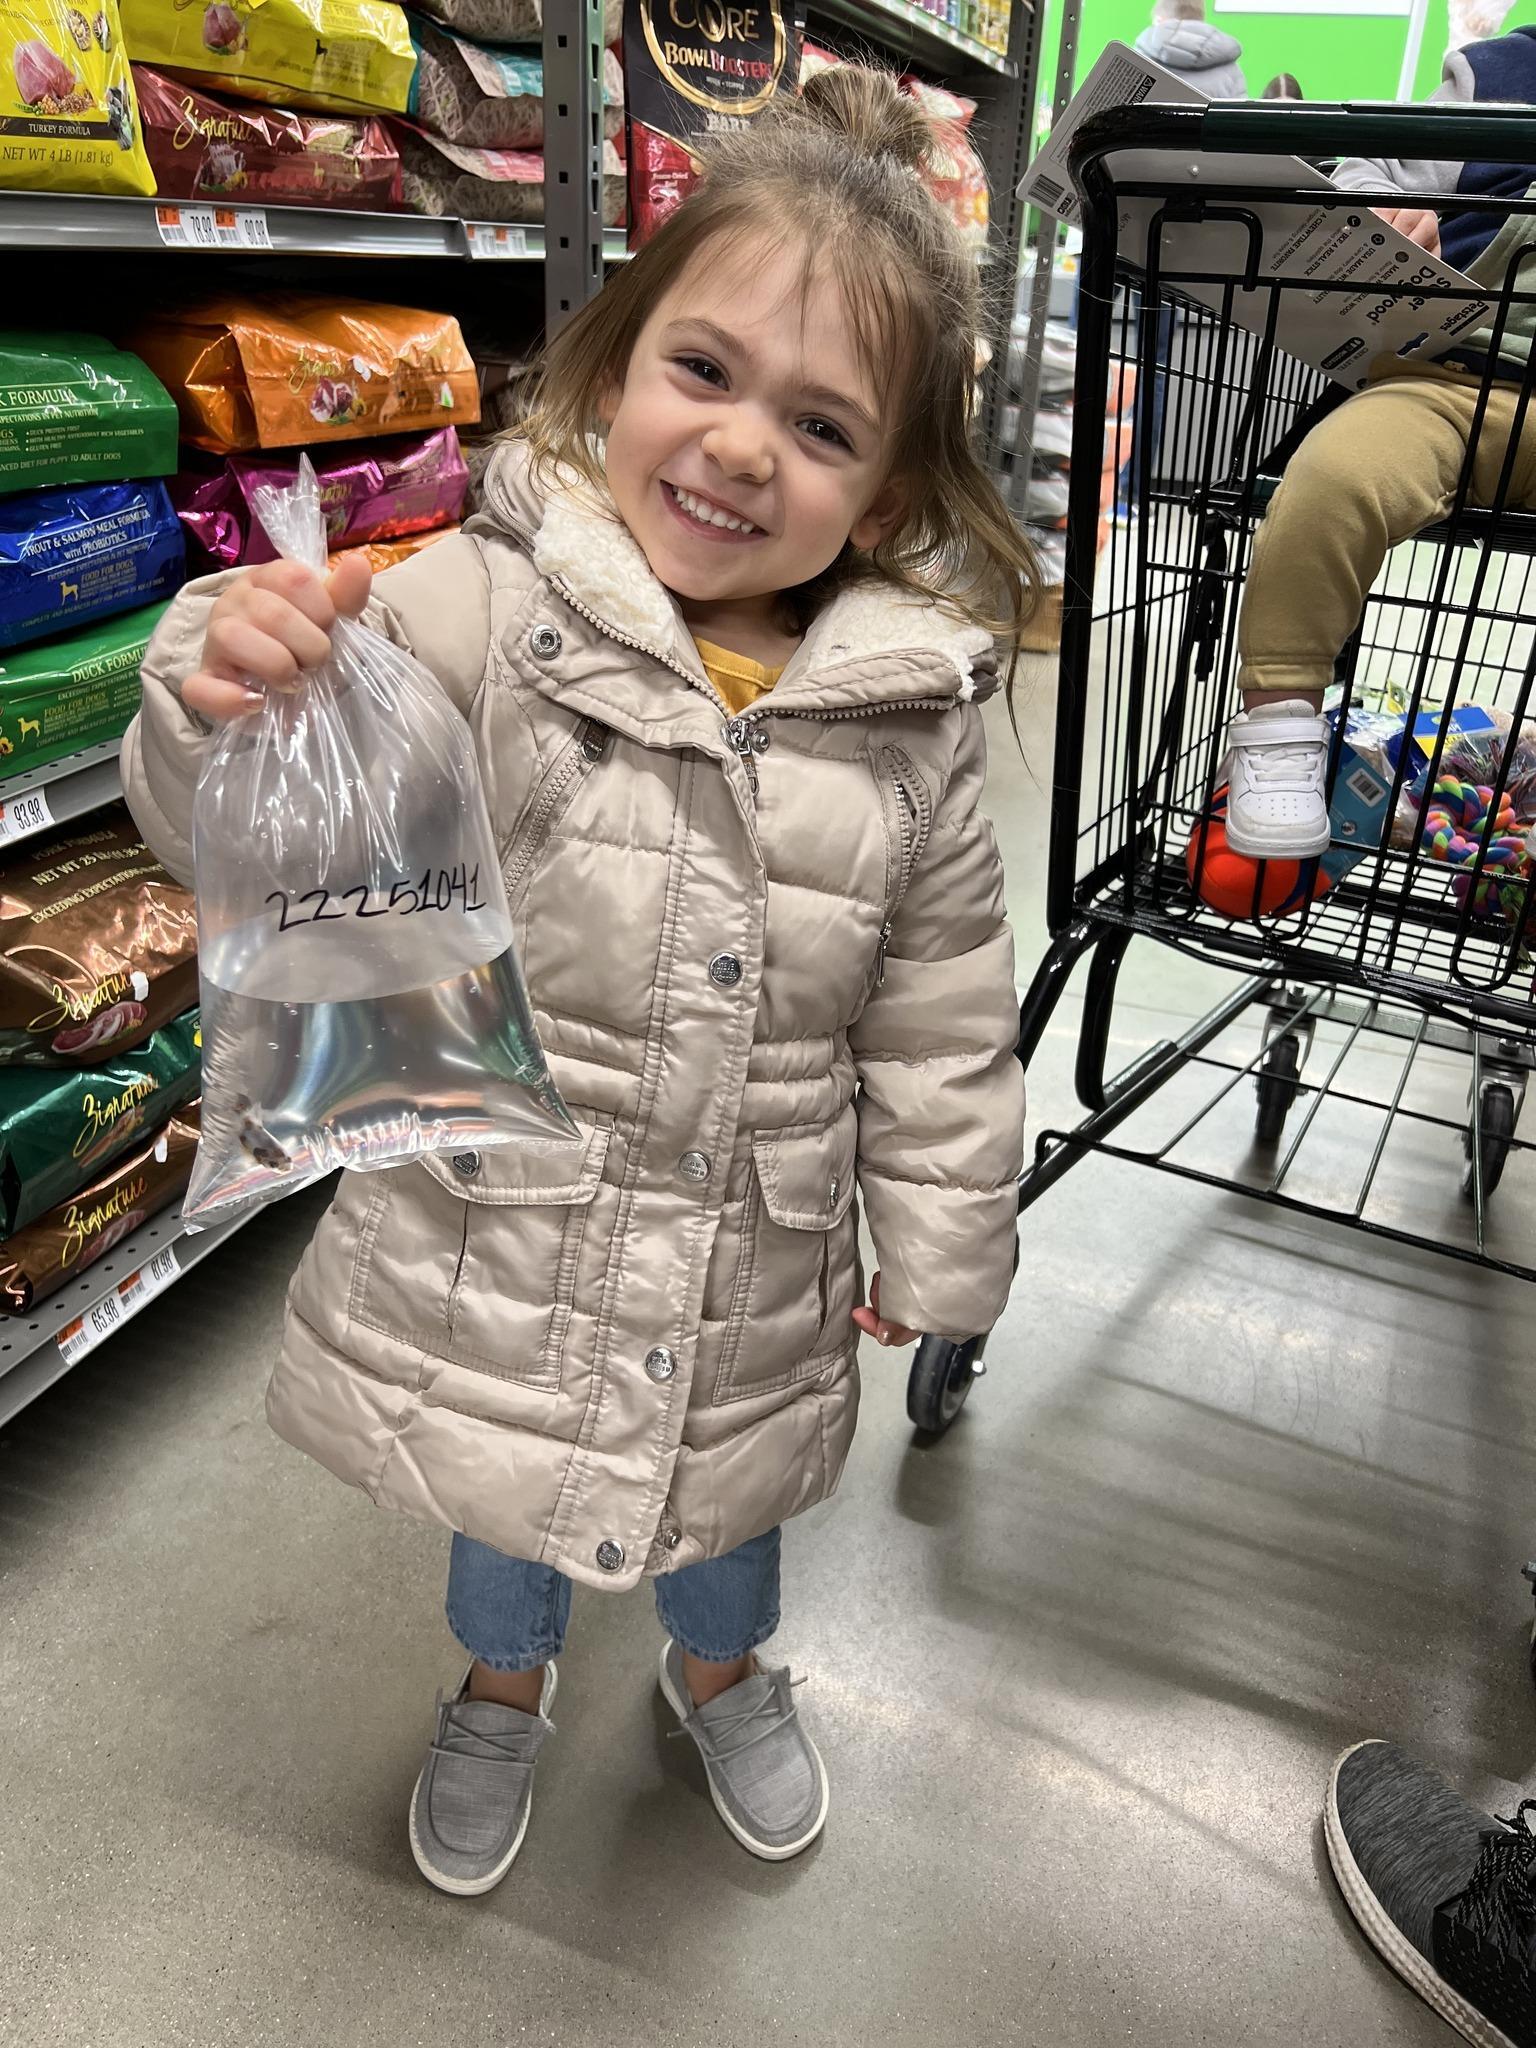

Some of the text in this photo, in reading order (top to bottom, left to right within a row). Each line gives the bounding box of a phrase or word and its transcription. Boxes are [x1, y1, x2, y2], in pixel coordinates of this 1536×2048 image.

[670, 0, 760, 43] CORE
[28, 123, 91, 136] TURKEY FORMULA
[3, 146, 114, 167] NET WT 4 LB (1.81 kg)
[1345, 258, 1364, 275] MADE
[1361, 247, 1376, 260] USA
[1379, 264, 1399, 281] MADE
[1408, 277, 1452, 311] Ser
[1440, 300, 1486, 332] Petstages
[9, 386, 78, 406] FORMULA
[25, 539, 52, 559] TROUT
[53, 538, 62, 550] &
[61, 528, 98, 547] SALMON
[97, 520, 119, 537] MEAL
[63, 531, 128, 561] WITH PROBIOTICS
[81, 559, 134, 583] FOOD FOR DOGS
[71, 646, 147, 684] DUCK FORMU
[14, 797, 45, 831] 93.98
[31, 867, 60, 887] NET
[57, 859, 82, 876] WT
[79, 854, 98, 867] 25
[31, 890, 86, 924] EXCEEDING
[265, 862, 487, 932] 22251041
[73, 1073, 161, 1159] Zignature
[62, 1177, 149, 1268] Zignature
[91, 1297, 120, 1334] 65.98
